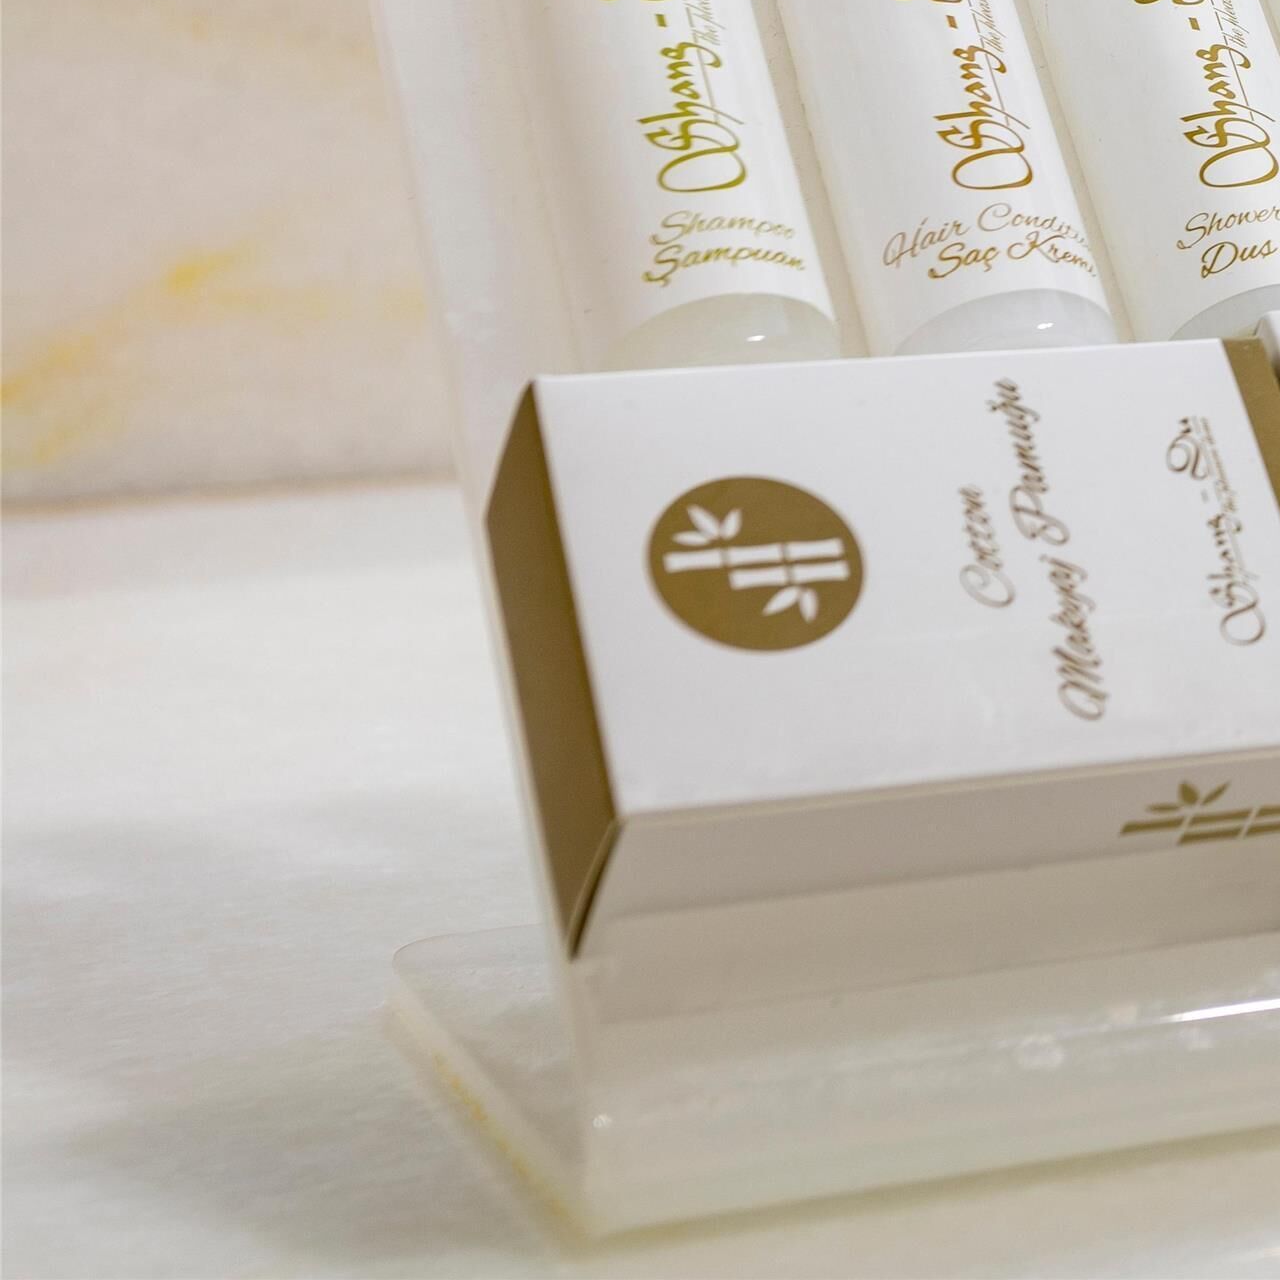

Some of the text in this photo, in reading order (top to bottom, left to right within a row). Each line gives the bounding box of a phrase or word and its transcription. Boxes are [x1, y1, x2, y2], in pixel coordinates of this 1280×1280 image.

[882, 217, 969, 268] Hair
[928, 242, 999, 278] Saç
[641, 244, 806, 287] Şampuan
